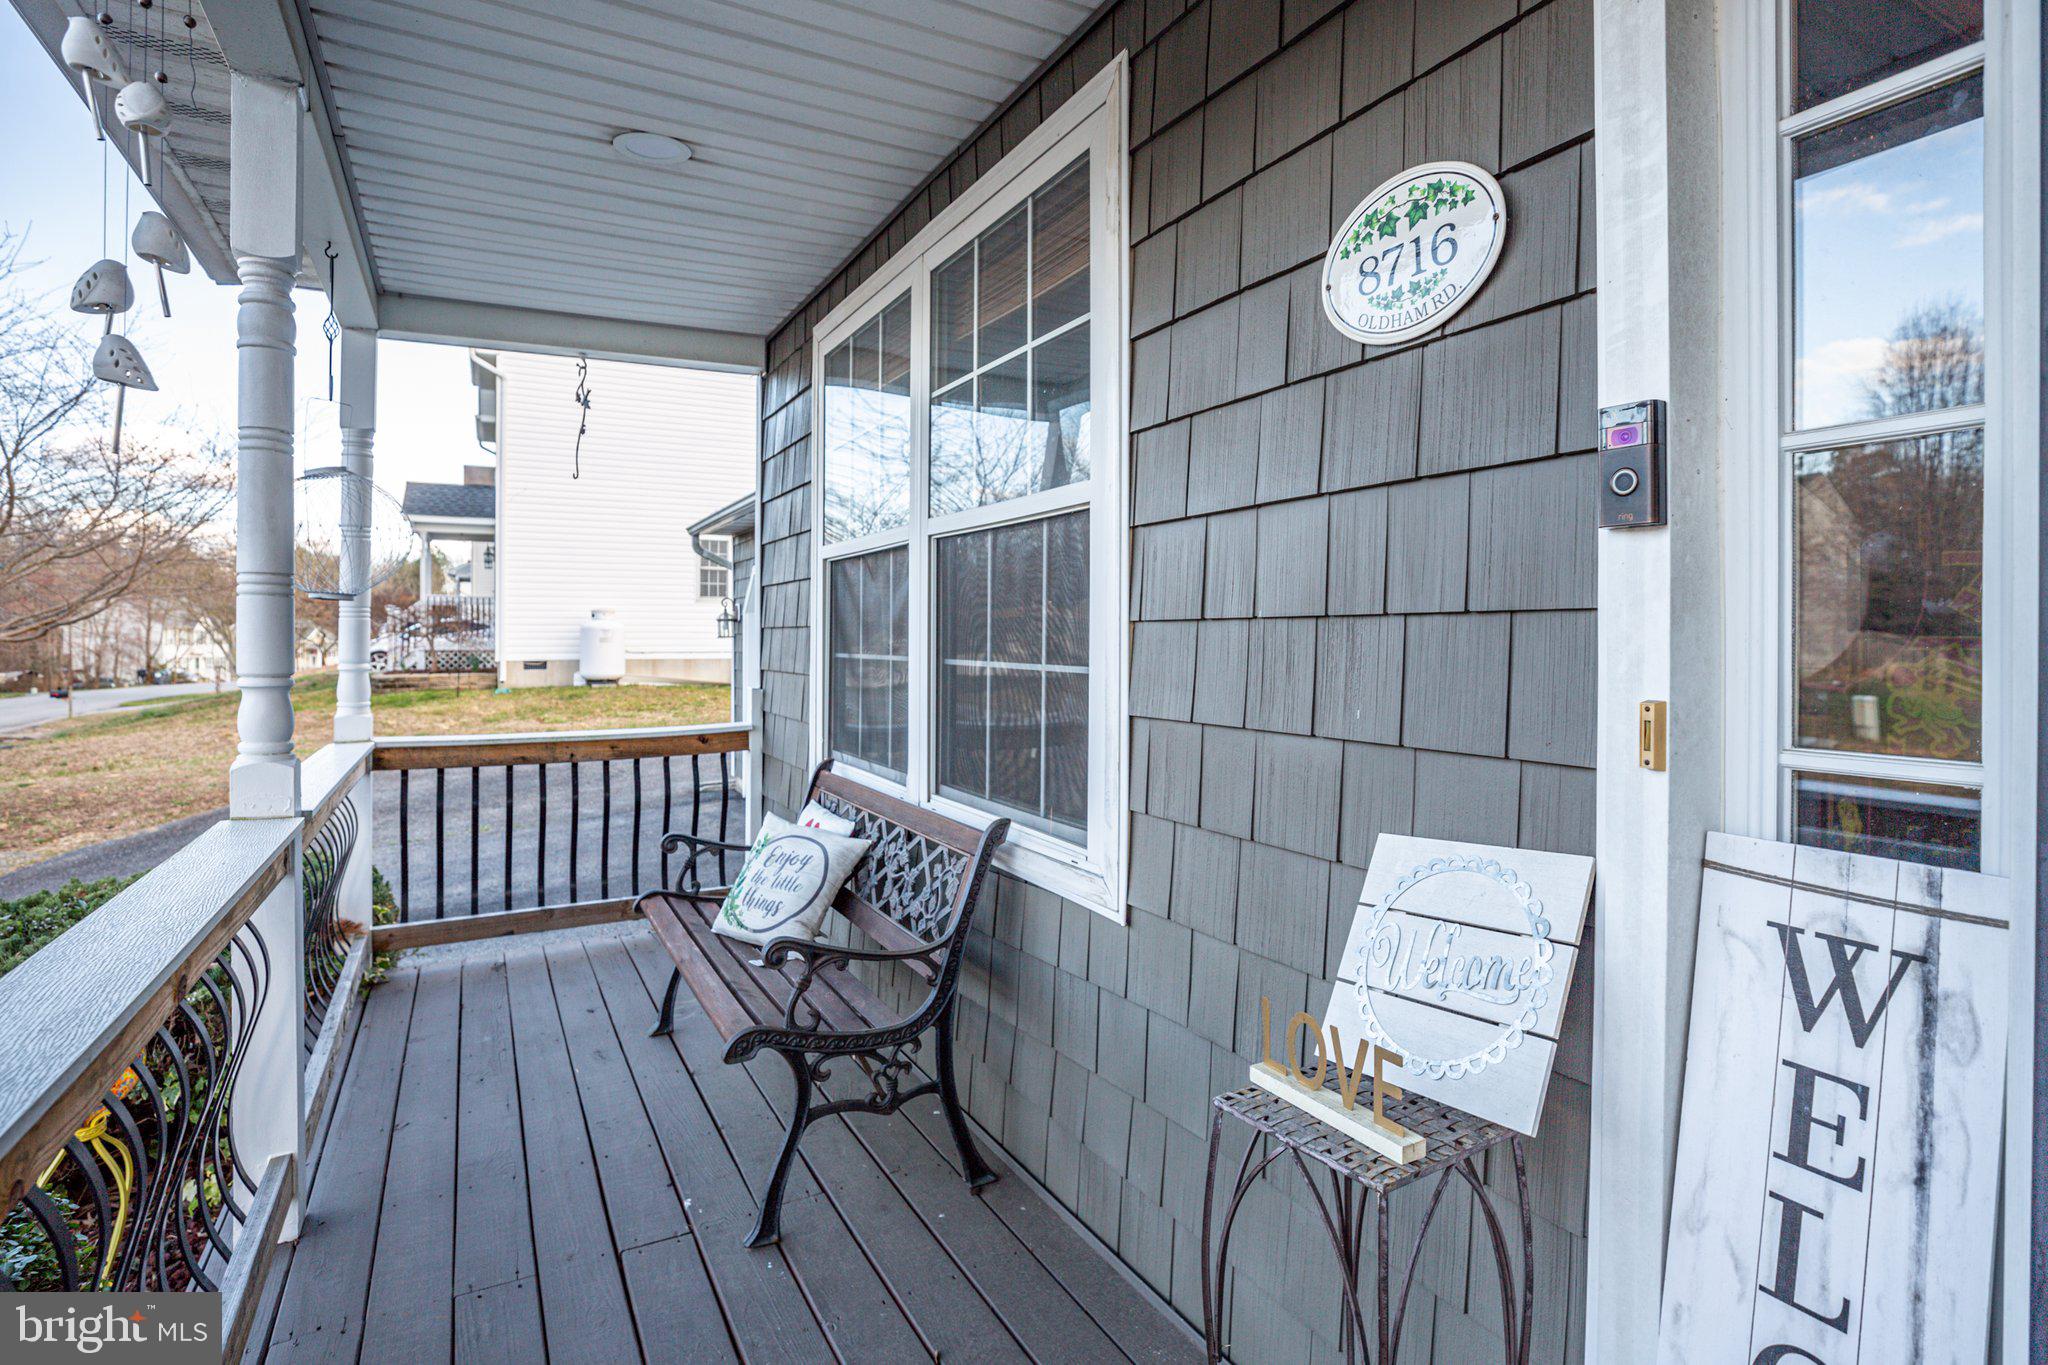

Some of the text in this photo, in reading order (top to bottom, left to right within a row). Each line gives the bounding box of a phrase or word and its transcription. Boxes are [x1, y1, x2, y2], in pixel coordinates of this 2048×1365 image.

[1358, 222, 1459, 297] 8716
[1358, 283, 1463, 330] OLDHAM RD.
[1617, 511, 1634, 522] ring
[751, 868, 804, 894] the little
[763, 845, 815, 876] Enjoy
[741, 887, 785, 918] things
[1371, 919, 1533, 1005] Welcome
[1260, 996, 1406, 1138] LOVE
[1750, 920, 1928, 1365] WEL
